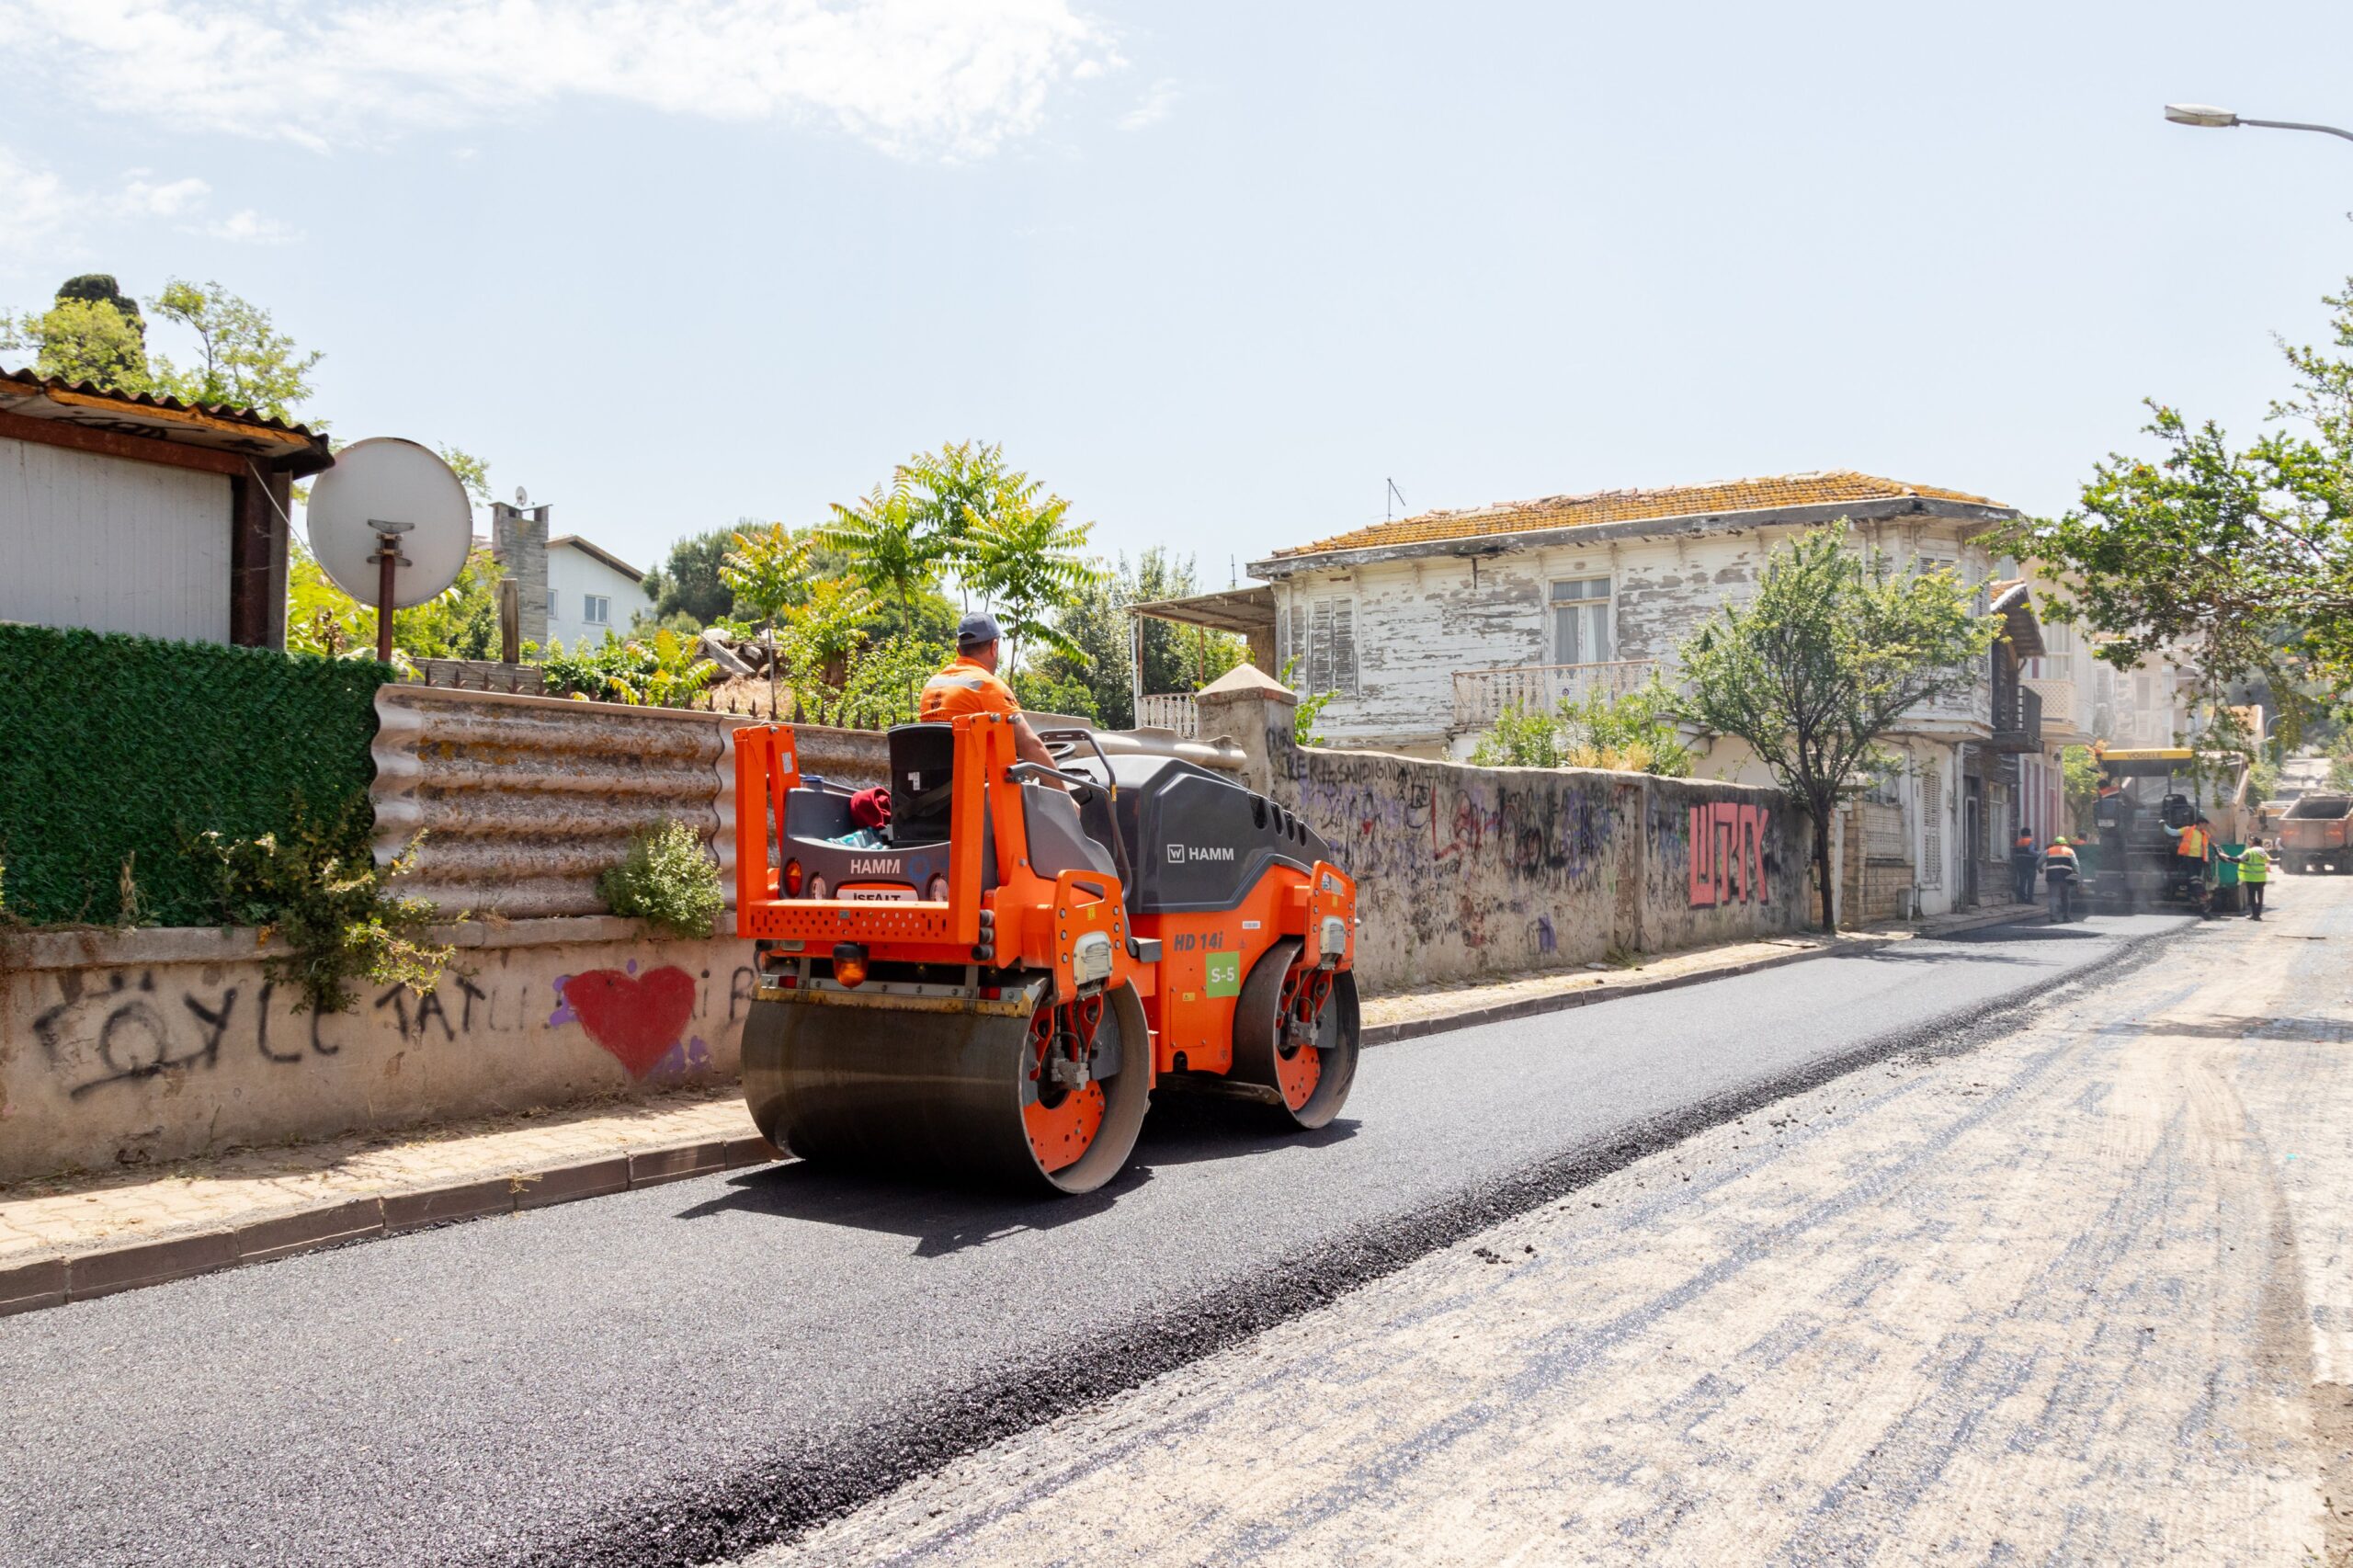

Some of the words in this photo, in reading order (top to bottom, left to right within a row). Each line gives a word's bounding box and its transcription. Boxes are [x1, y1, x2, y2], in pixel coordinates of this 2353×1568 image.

[1188, 847, 1234, 861] HAMM
[850, 858, 901, 874] HAMM
[1174, 933, 1197, 951] HD
[1199, 931, 1223, 949] 14i
[1211, 967, 1235, 983] S-5
